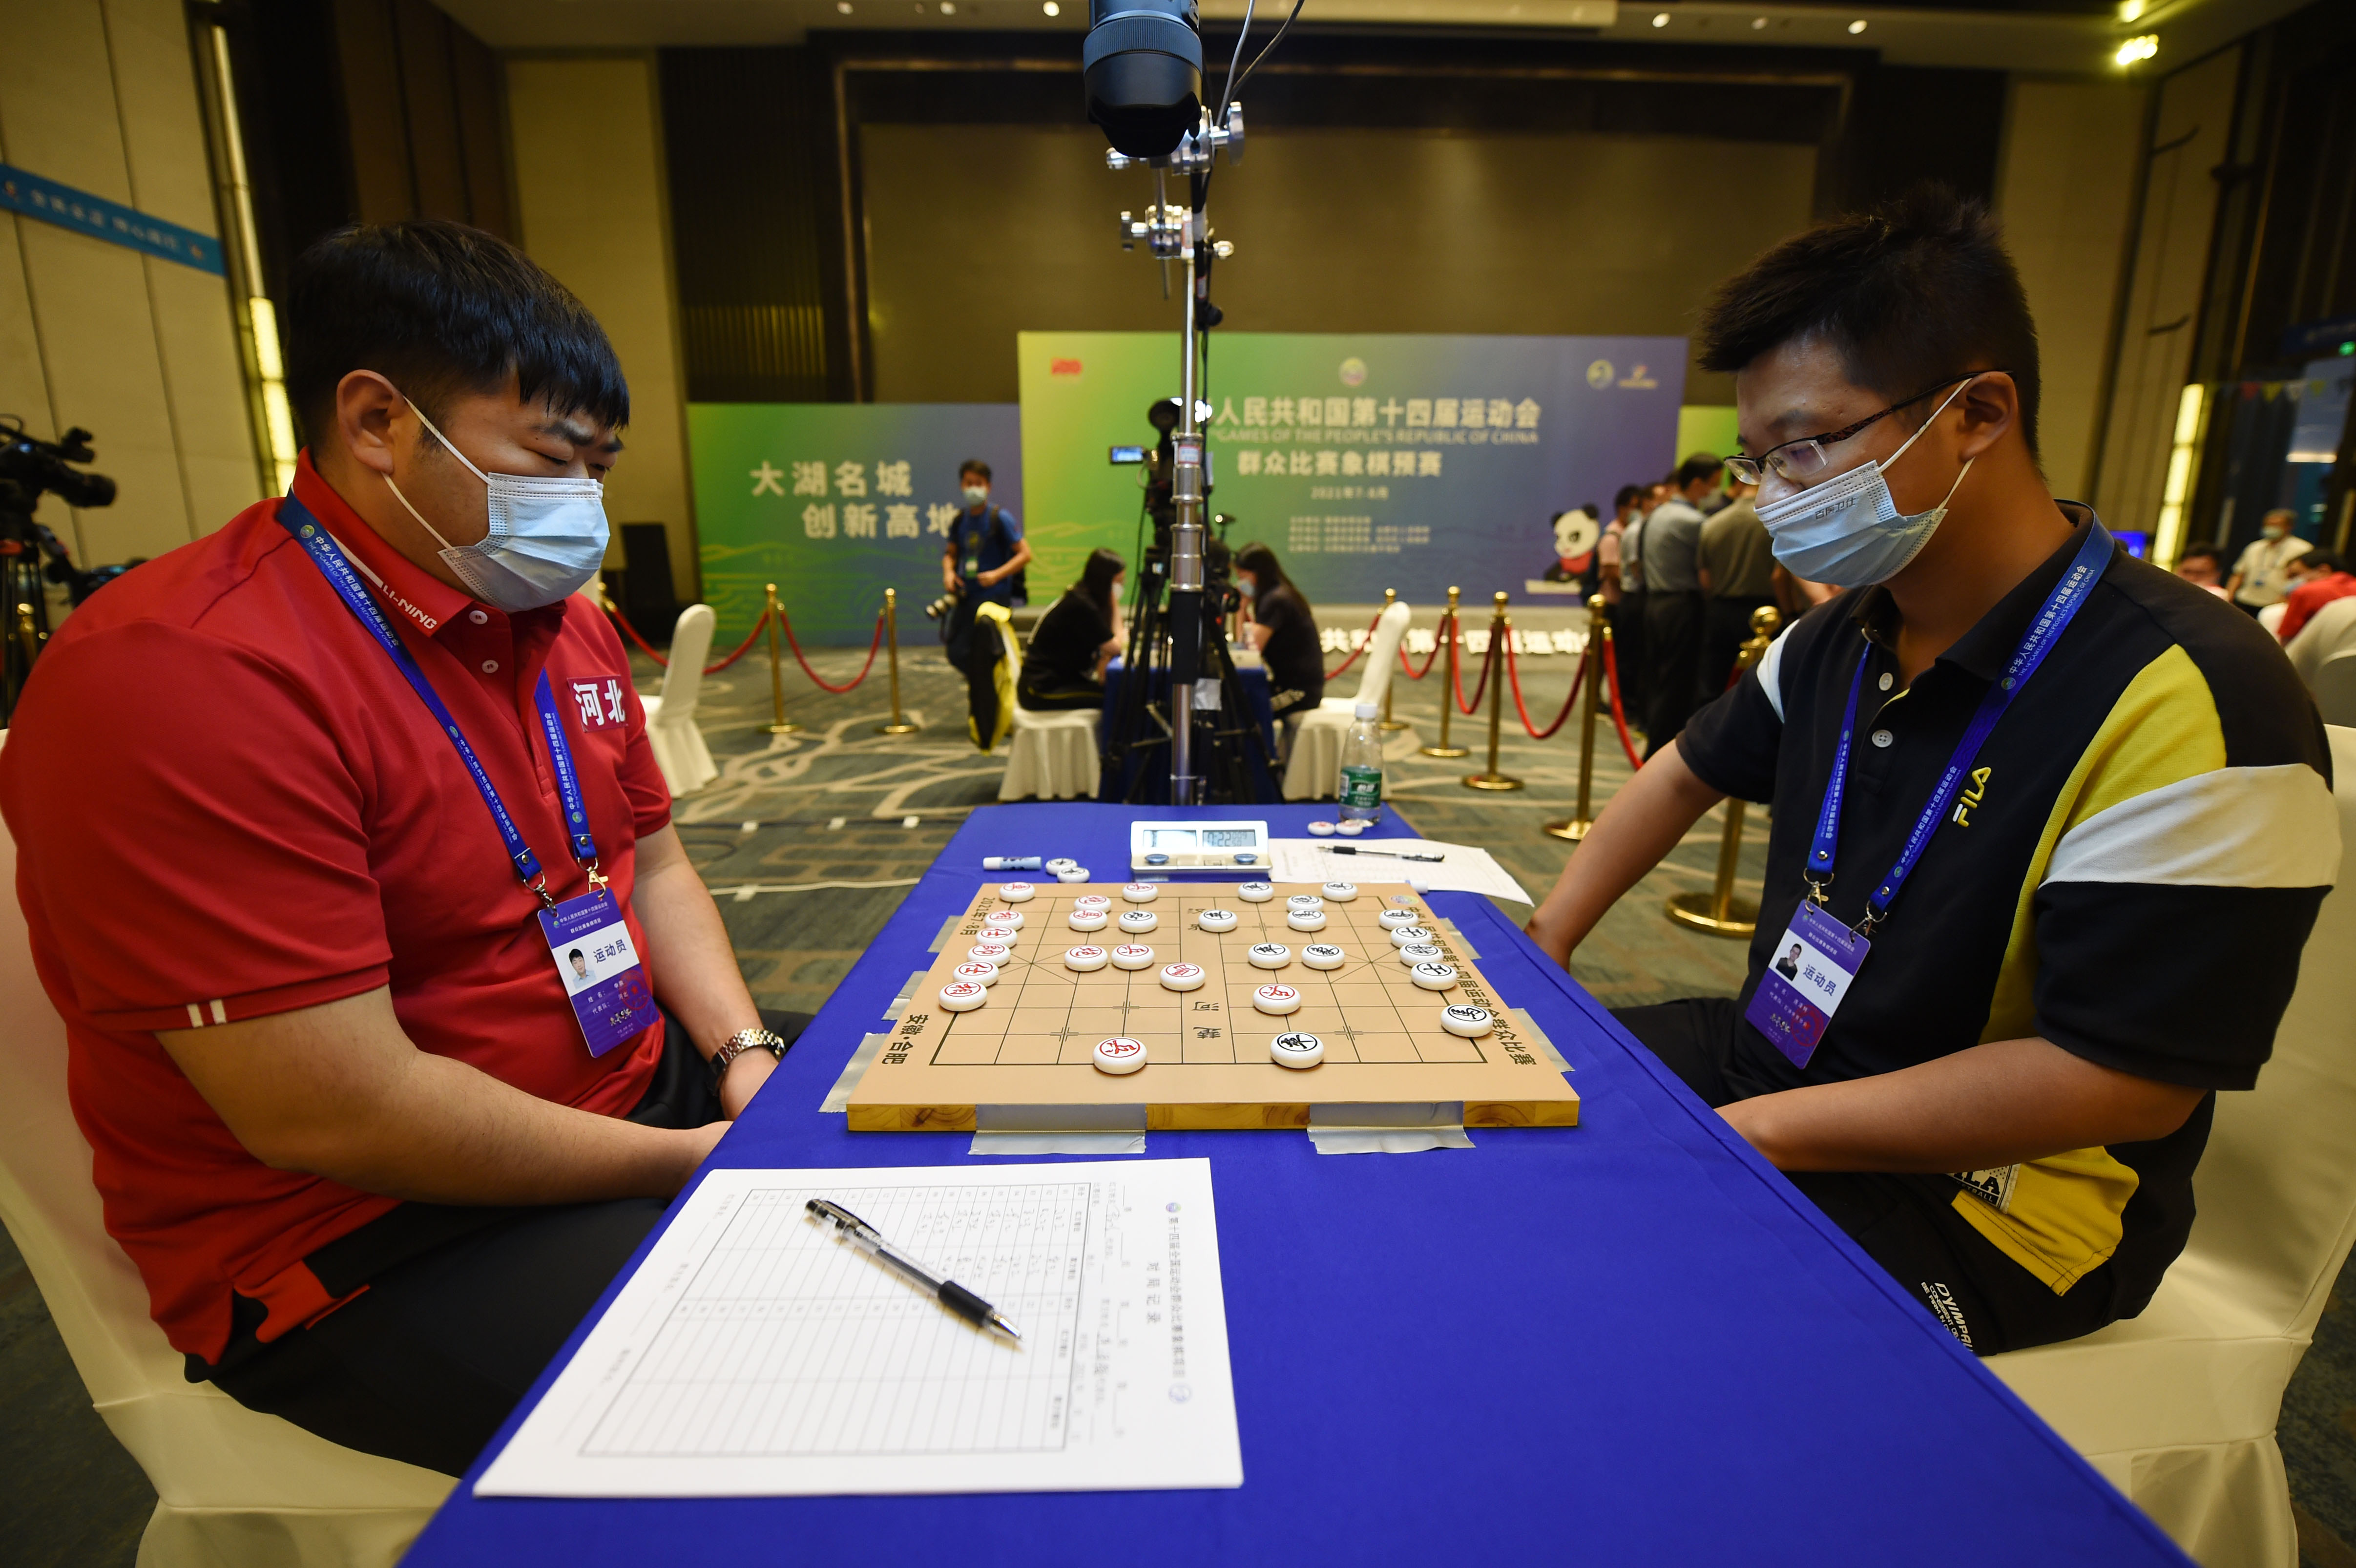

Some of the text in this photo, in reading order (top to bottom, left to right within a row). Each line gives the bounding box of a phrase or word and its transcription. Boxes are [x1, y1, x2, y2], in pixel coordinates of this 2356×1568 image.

[750, 460, 913, 497] 大湖名城
[802, 503, 960, 538] 创新高地
[315, 536, 399, 647] 中华人民共和国第十四届运动会
[319, 555, 334, 571] GAMES
[381, 633, 394, 649] CHINA
[382, 585, 438, 629] LI-NING
[2029, 644, 2044, 662] GAMES
[2083, 568, 2095, 583] CHINA
[2009, 565, 2087, 674] 中华人民共和国第十四届运动会
[573, 679, 625, 726] 河北
[1952, 767, 1992, 828] FILA
[593, 939, 627, 964] 运动员
[1803, 964, 1836, 997] 运动员
[881, 1013, 929, 1066] 安徽·合肥
[1921, 1281, 1930, 1294] BE
[1934, 1282, 1973, 1352] DYIMPA
